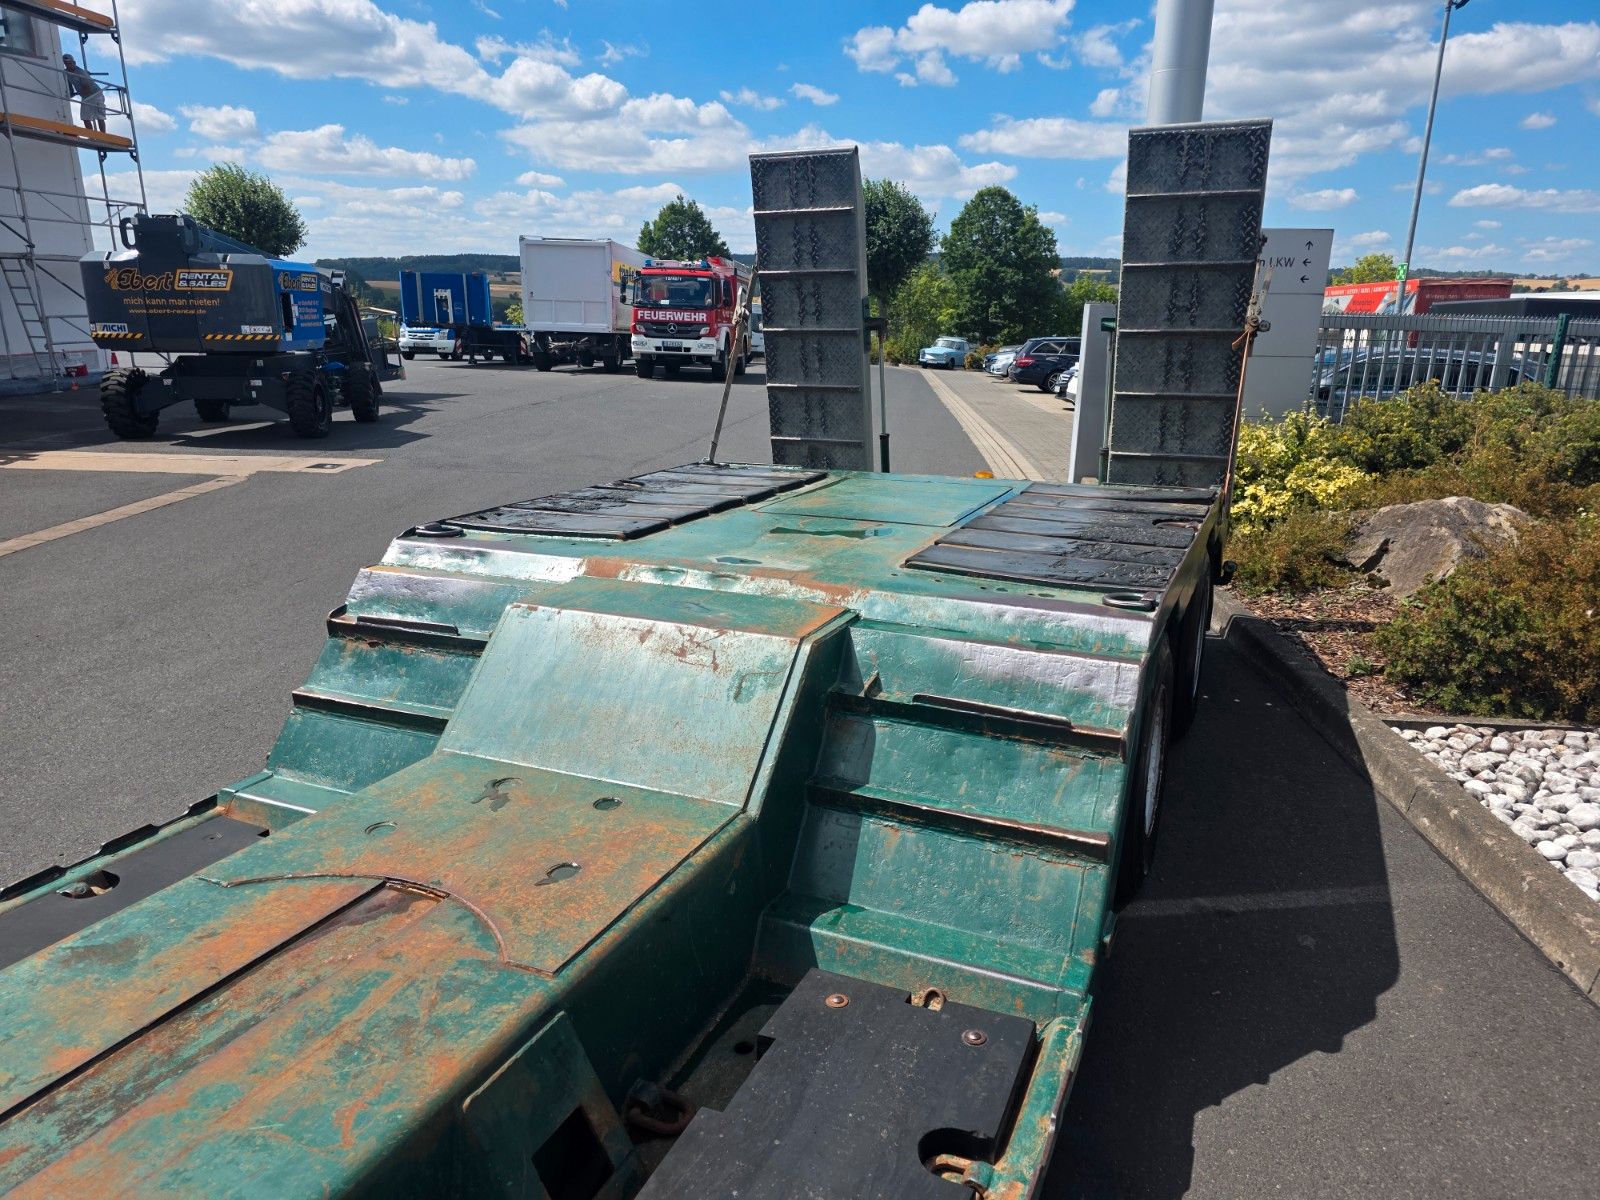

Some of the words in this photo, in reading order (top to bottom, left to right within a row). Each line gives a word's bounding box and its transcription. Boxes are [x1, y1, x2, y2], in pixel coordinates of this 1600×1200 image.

[117, 267, 173, 290] Ebert
[179, 272, 227, 280] RENTAL
[123, 297, 144, 305] mich
[146, 297, 167, 305] kann
[189, 297, 220, 306] mieten!
[637, 310, 707, 322] FEUERWEHR
[101, 324, 127, 332] AICHI
